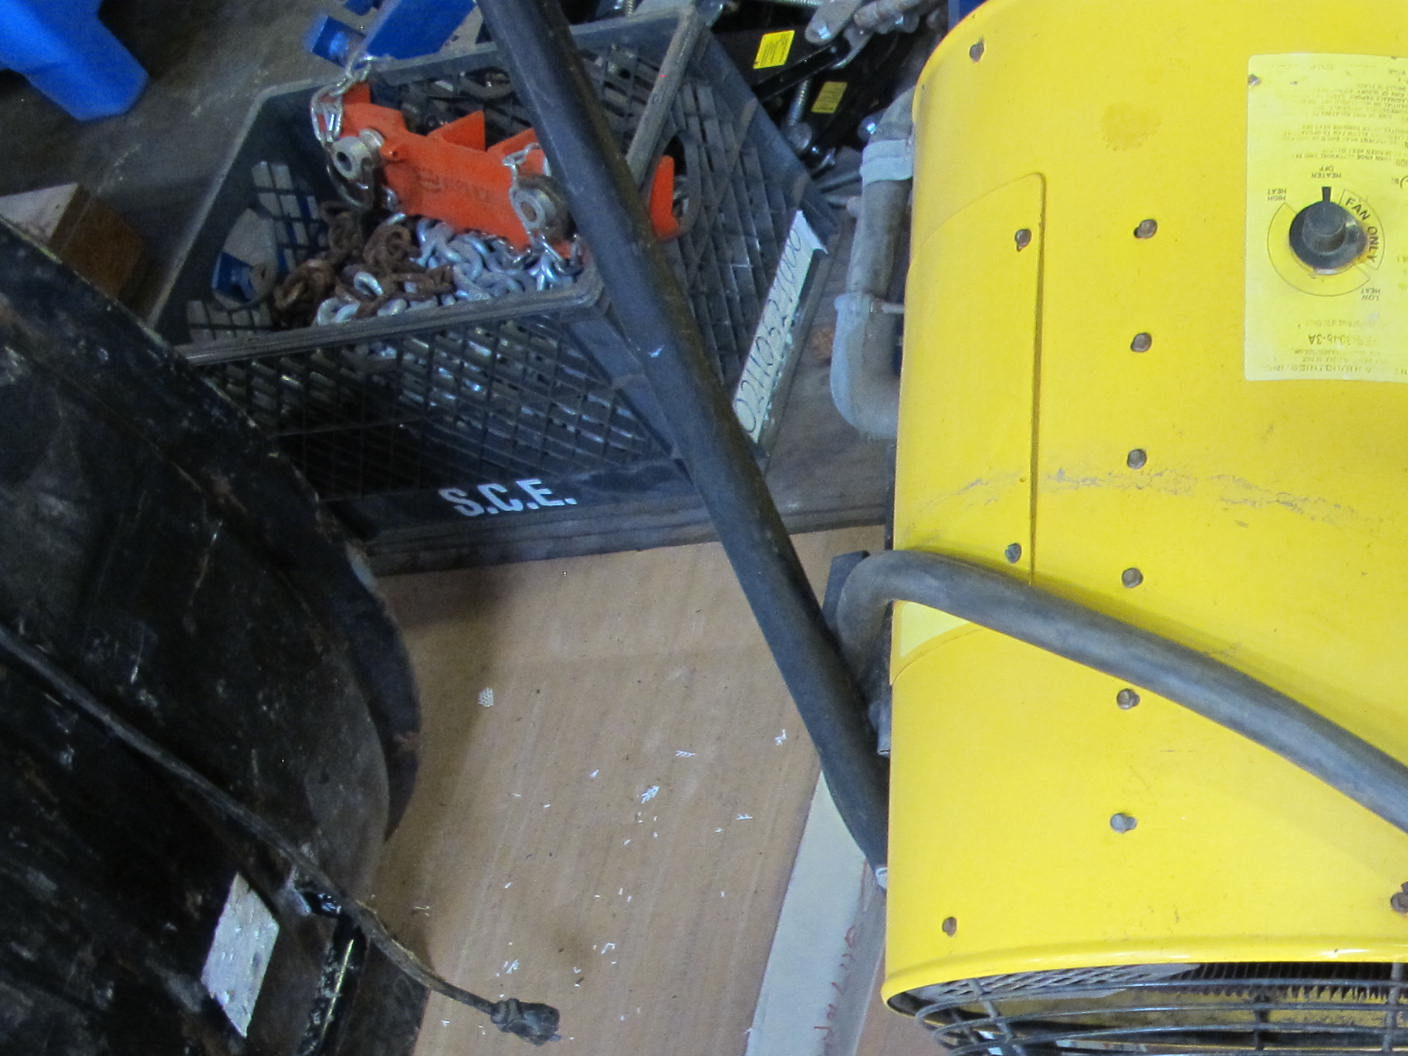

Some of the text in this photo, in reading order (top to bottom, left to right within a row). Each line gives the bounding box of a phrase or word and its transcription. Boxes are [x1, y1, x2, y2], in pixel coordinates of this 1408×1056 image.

[1344, 196, 1378, 262] FAN ONLY
[438, 478, 578, 517] S.C.E.
